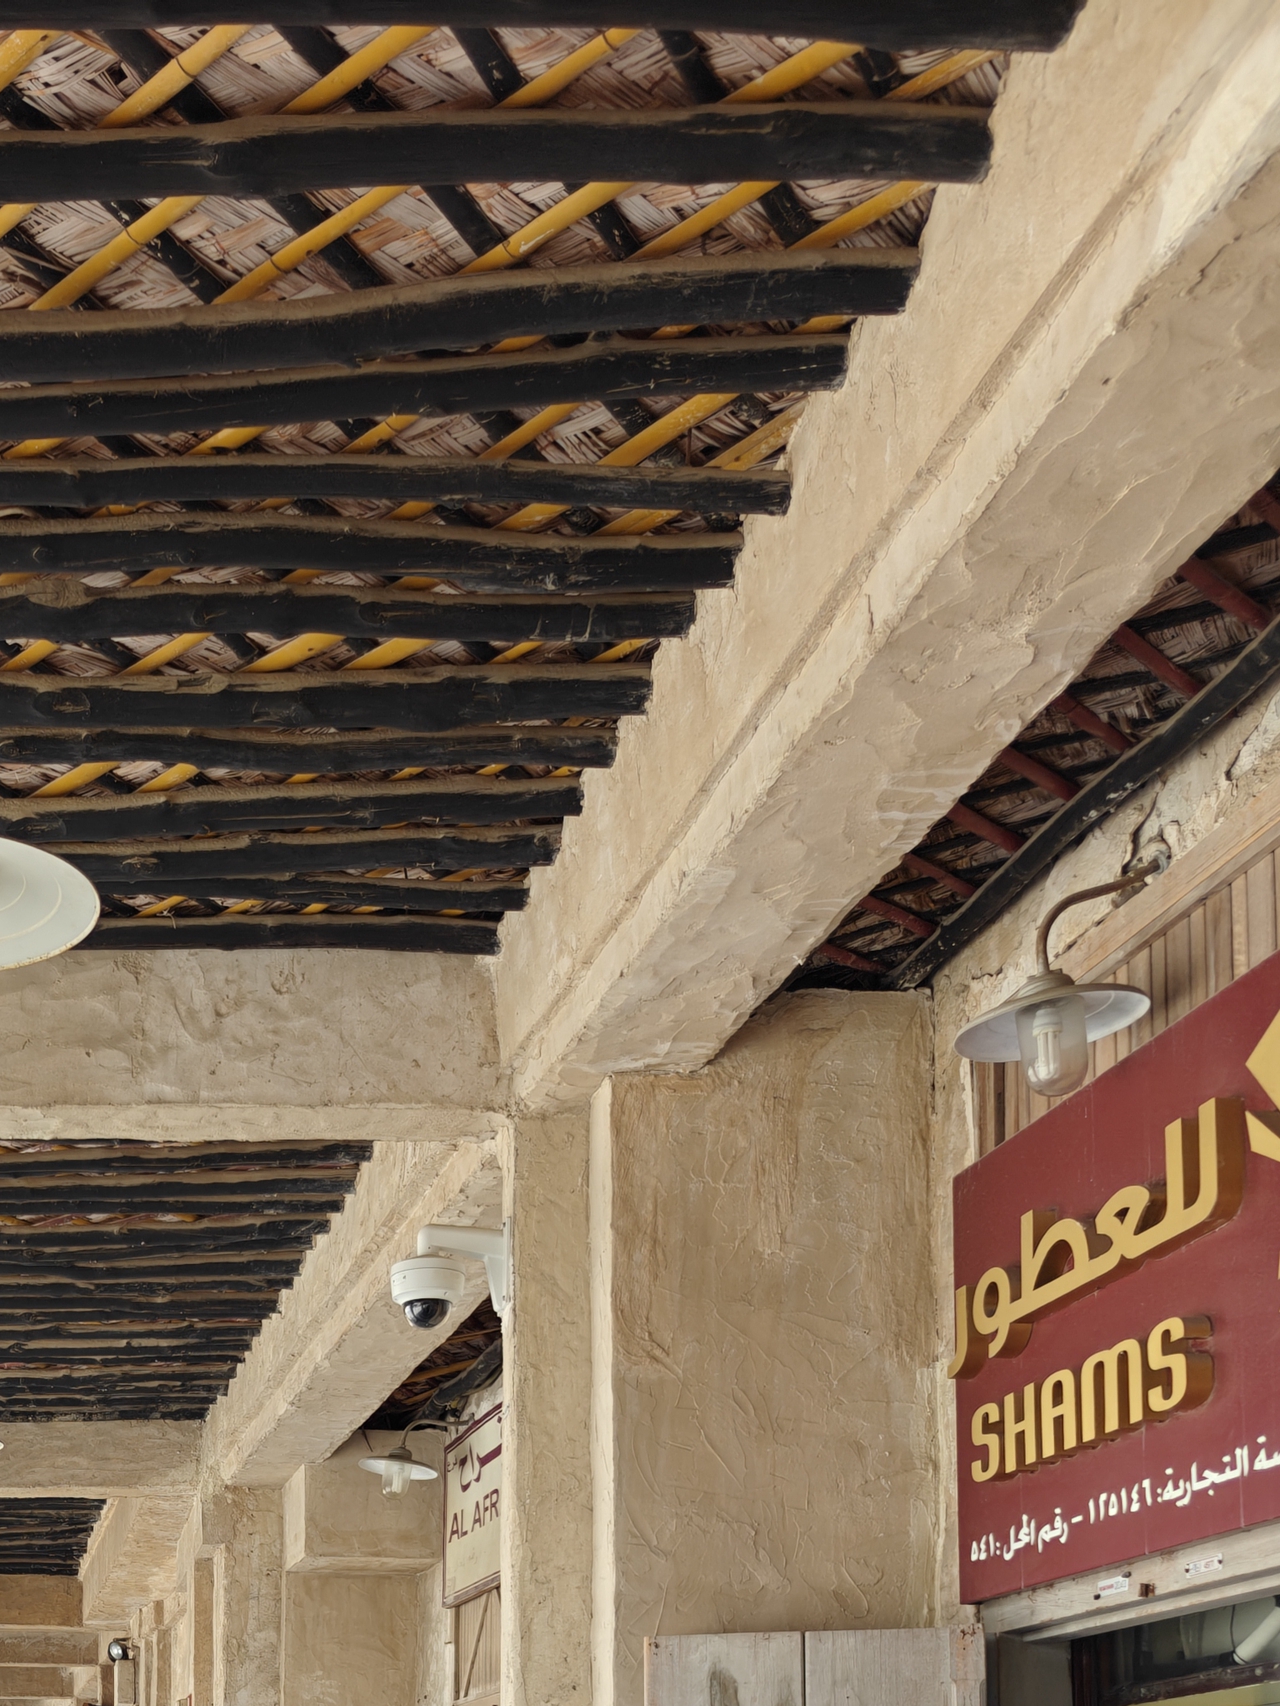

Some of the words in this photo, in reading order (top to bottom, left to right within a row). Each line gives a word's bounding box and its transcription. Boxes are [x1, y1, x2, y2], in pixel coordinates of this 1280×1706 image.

[947, 1097, 1219, 1379] للعطور
[971, 1316, 1188, 1483] SHAMS
[448, 1509, 468, 1544] AL
[1037, 1507, 1069, 1553] رقم
